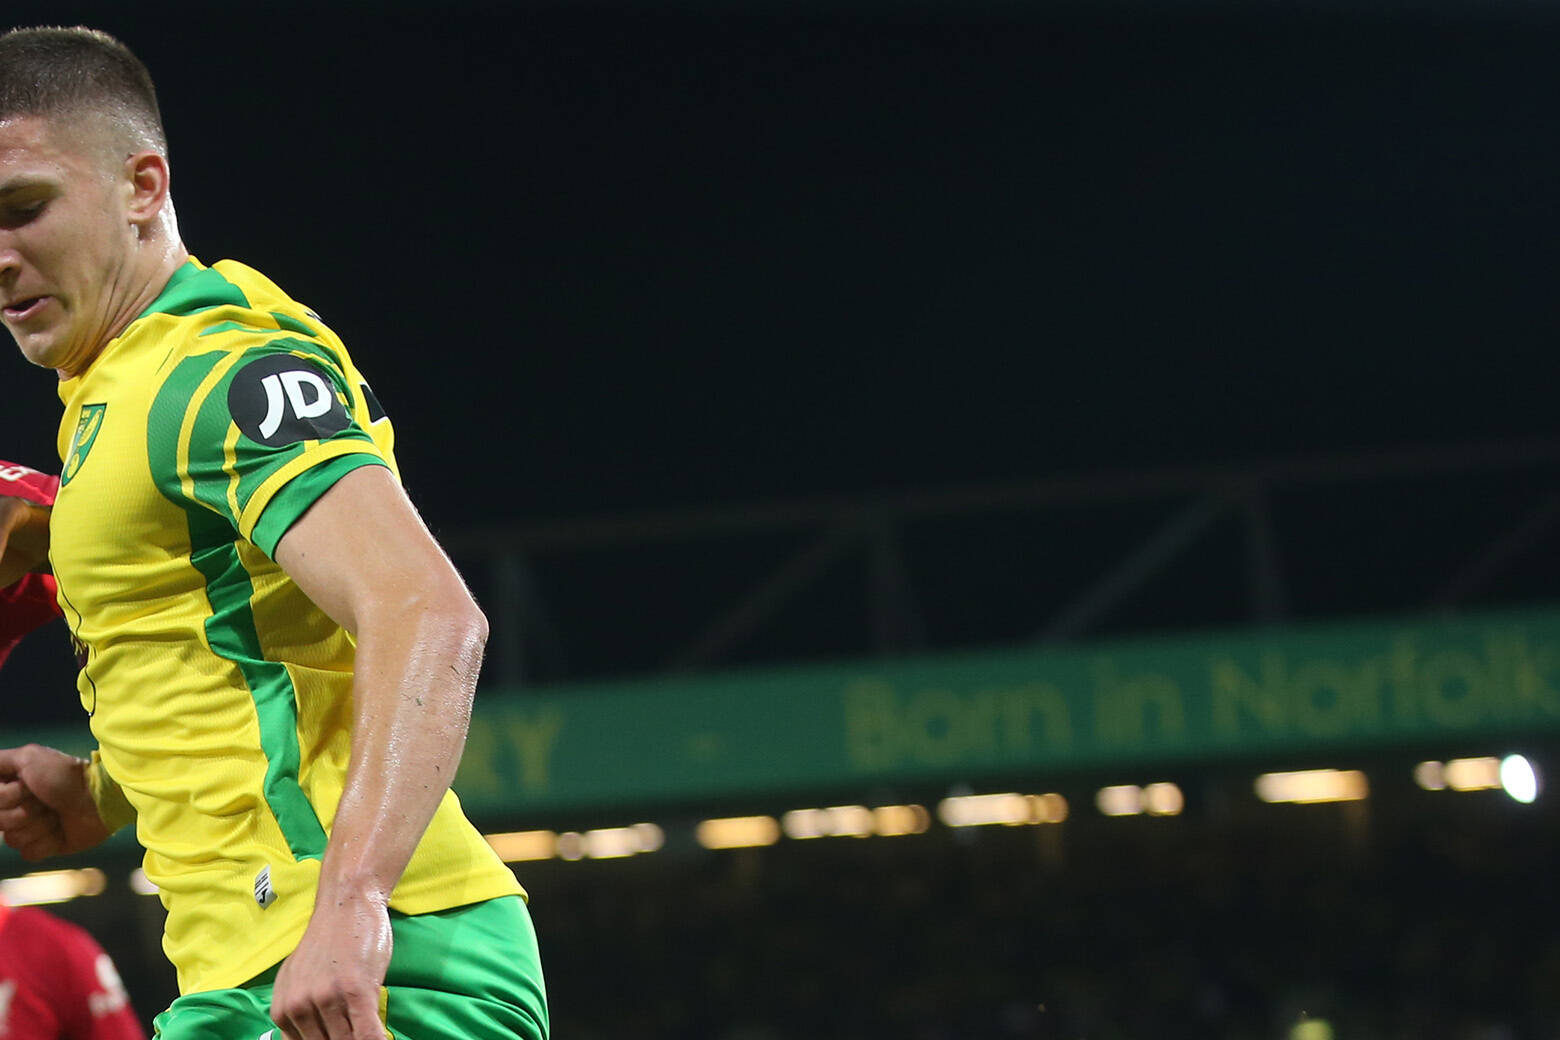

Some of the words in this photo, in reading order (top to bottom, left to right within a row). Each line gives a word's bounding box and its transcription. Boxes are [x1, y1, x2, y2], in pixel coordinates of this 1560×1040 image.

[257, 369, 333, 440] JD
[844, 676, 1072, 769] Born
[1093, 655, 1185, 747] in
